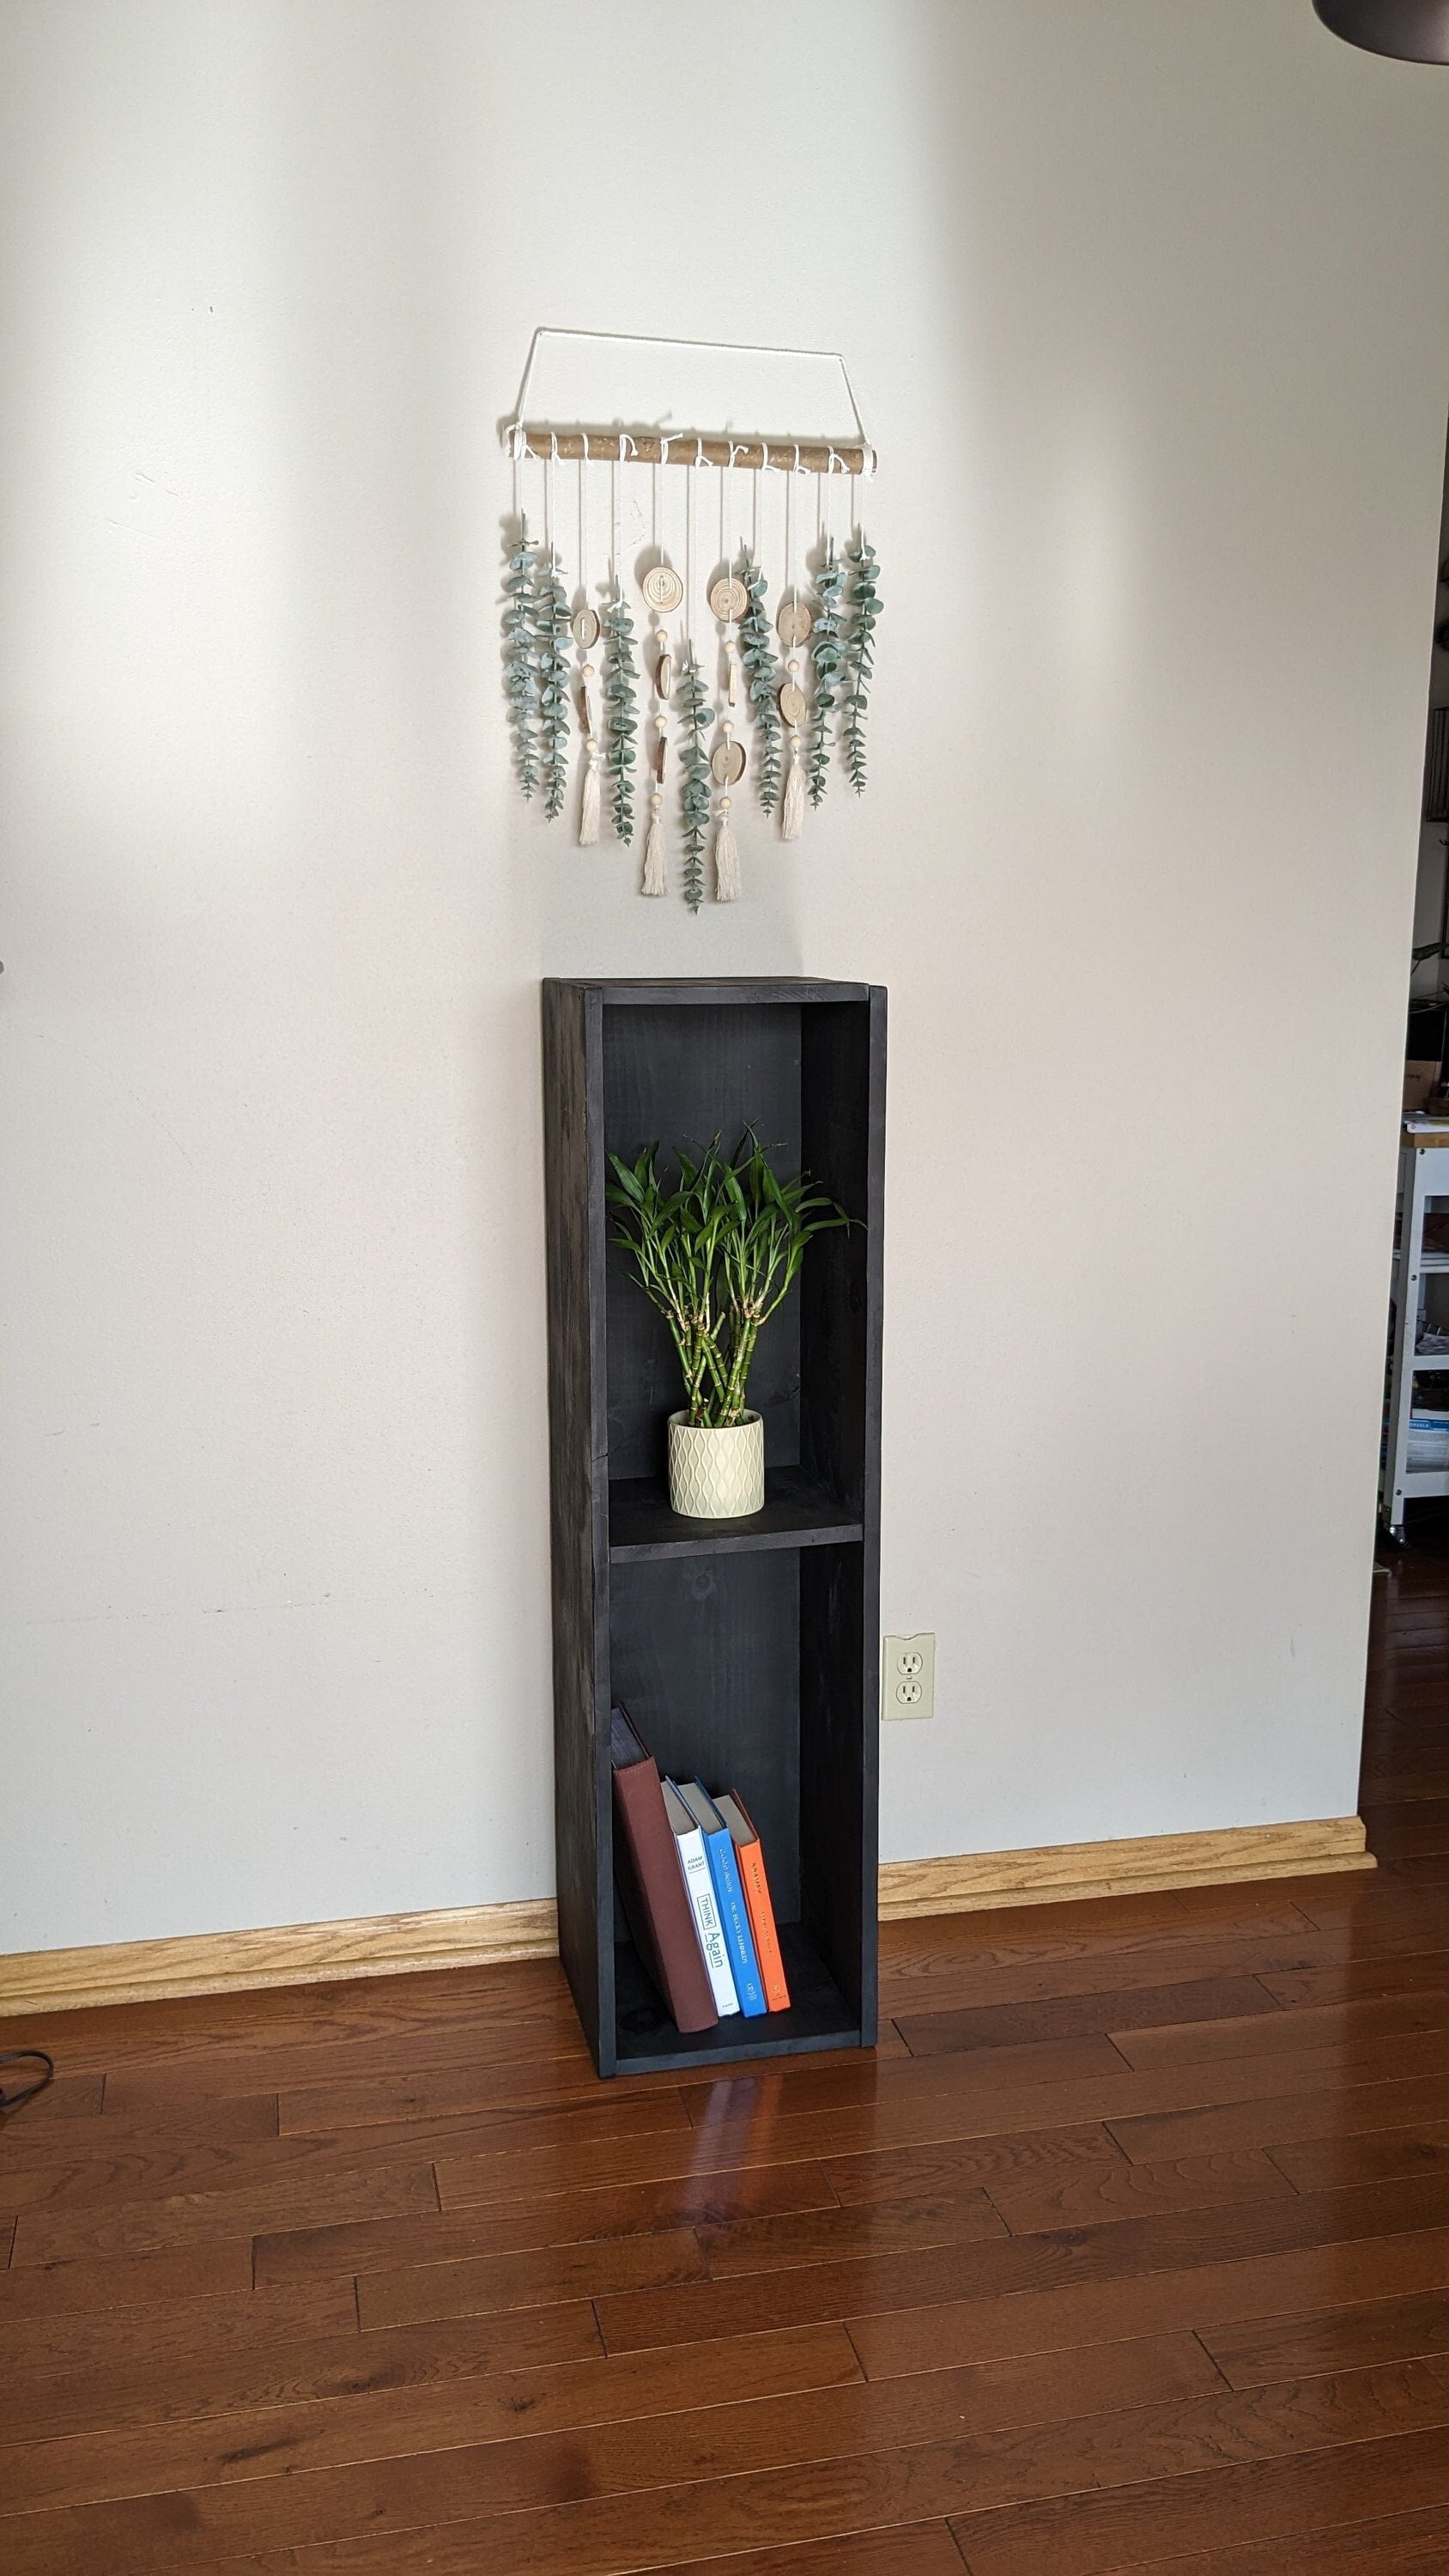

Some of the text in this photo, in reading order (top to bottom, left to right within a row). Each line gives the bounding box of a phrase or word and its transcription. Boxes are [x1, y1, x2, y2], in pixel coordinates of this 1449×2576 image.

[688, 1856, 703, 1864] ADAM
[688, 1862, 705, 1870] GRANT
[700, 1898, 724, 1968] THINK Again
